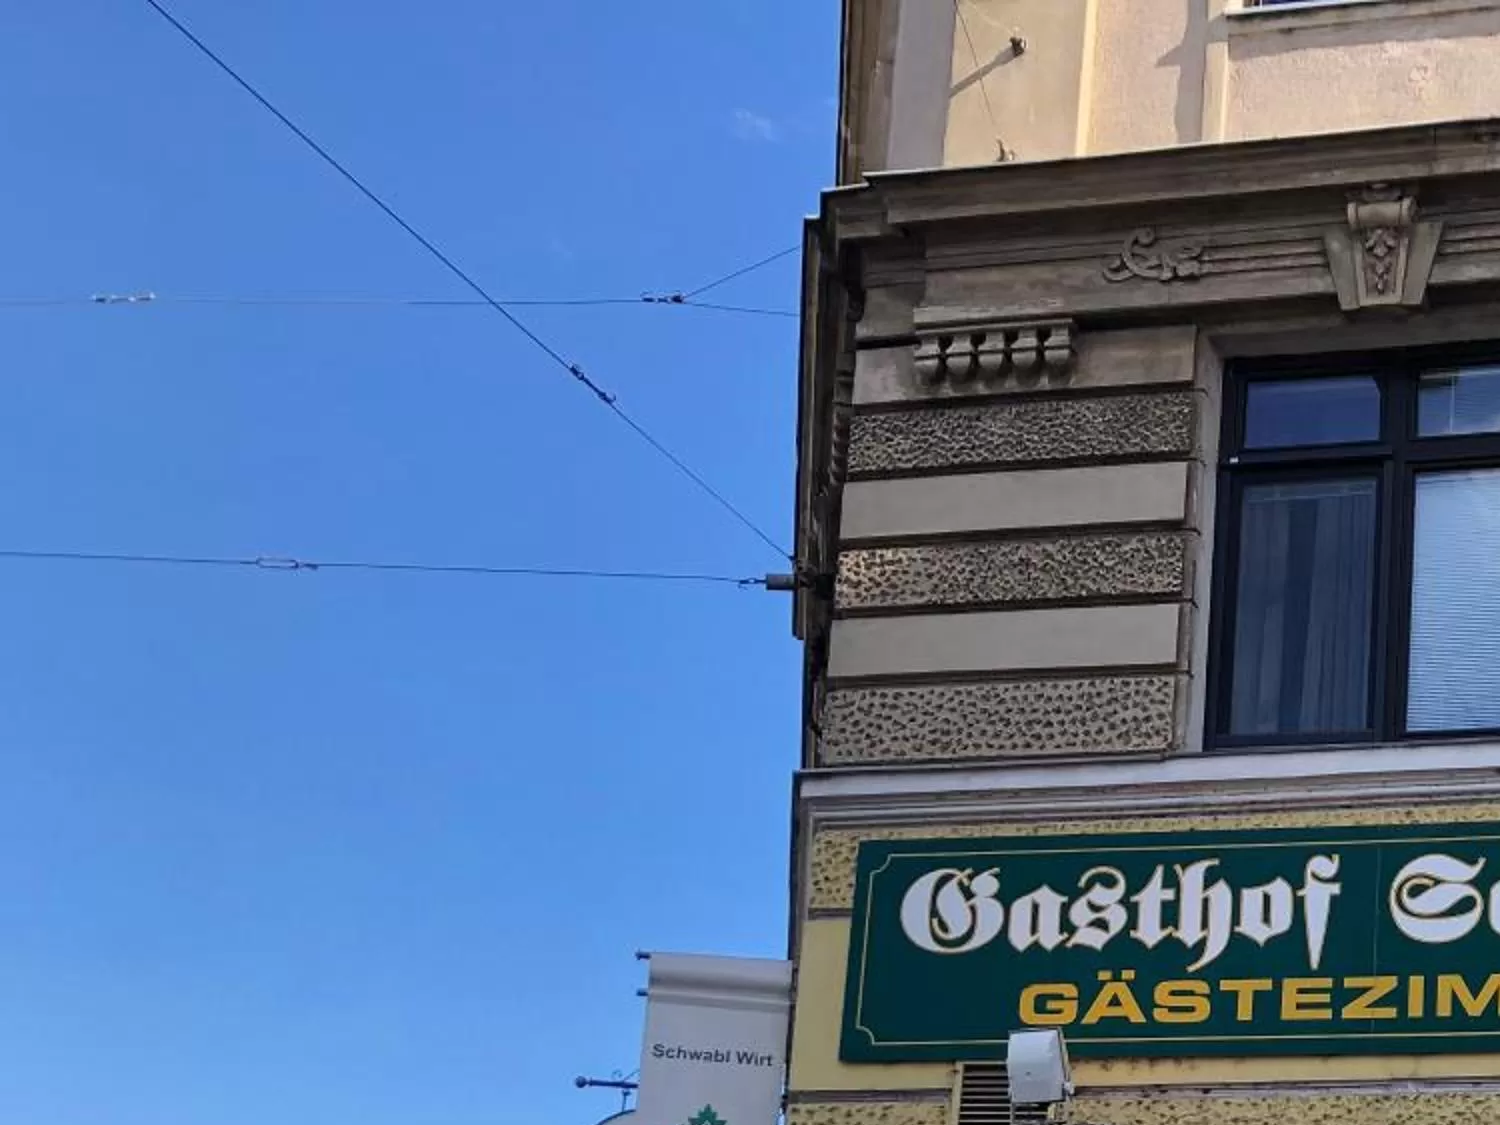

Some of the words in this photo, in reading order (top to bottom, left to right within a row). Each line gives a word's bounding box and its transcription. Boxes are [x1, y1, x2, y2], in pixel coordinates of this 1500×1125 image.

[899, 852, 1341, 972] Gasthof
[652, 1043, 731, 1065] Schwabl
[736, 1047, 774, 1068] Wirt
